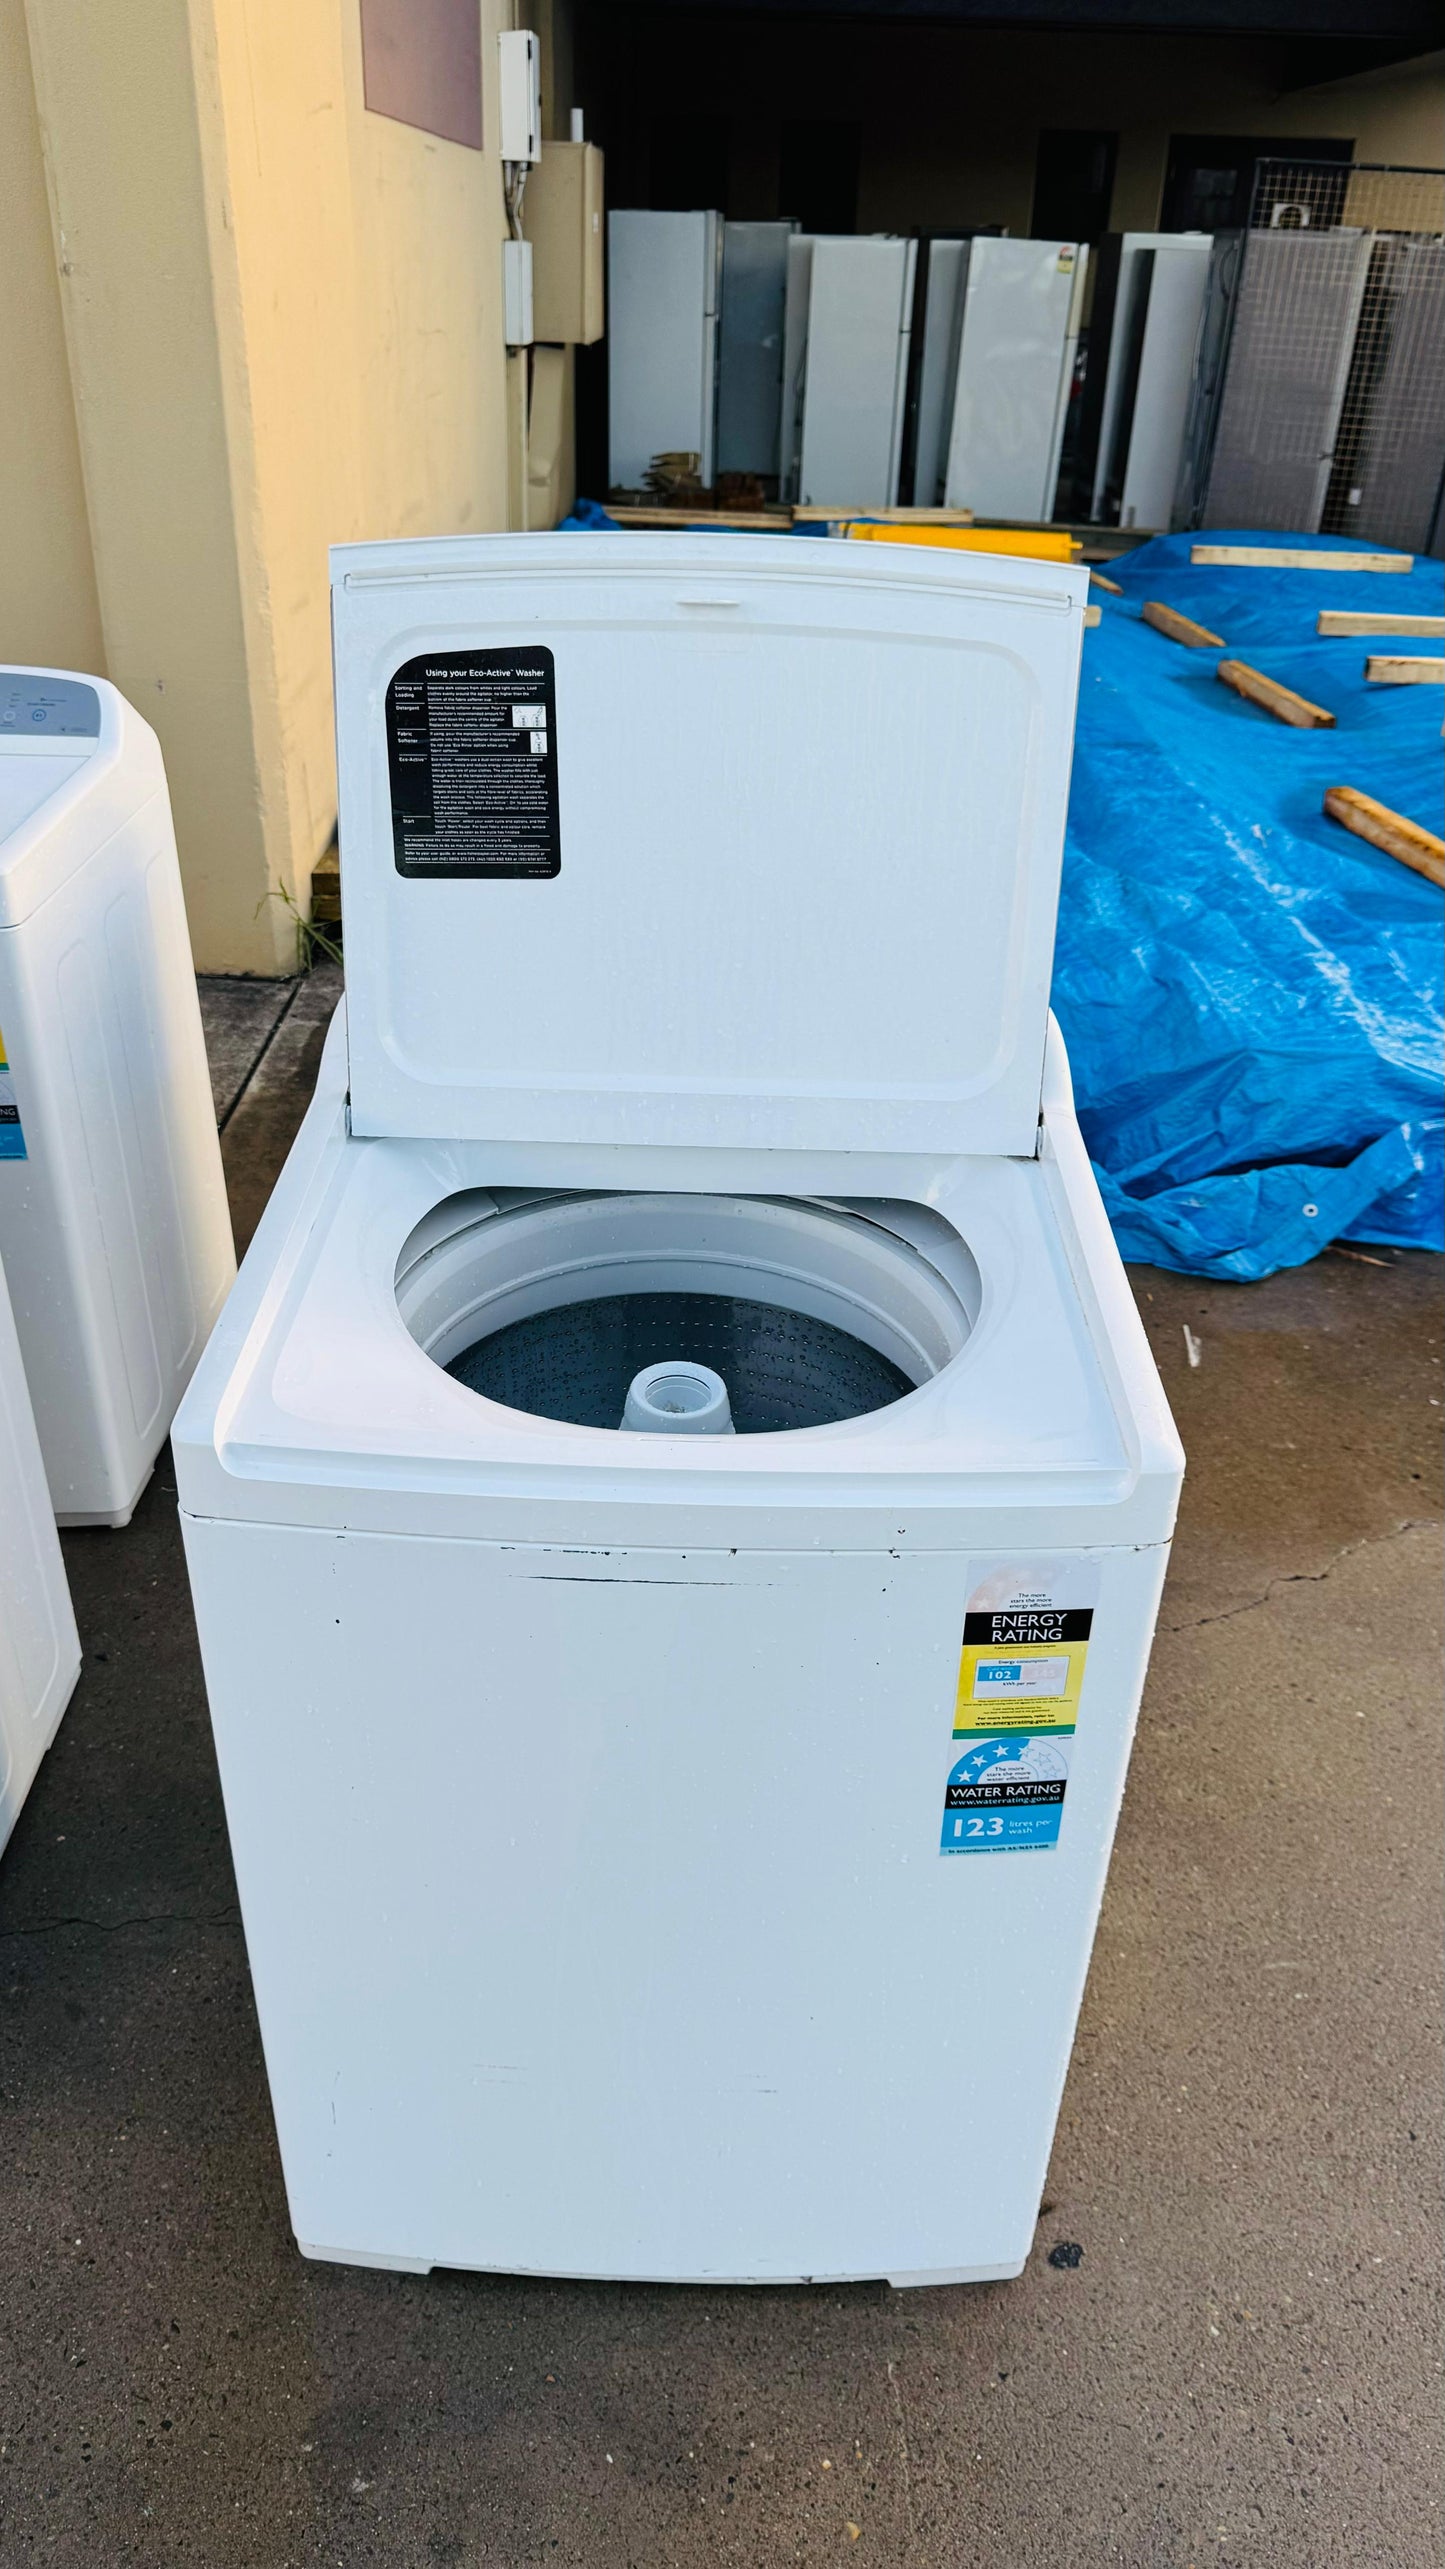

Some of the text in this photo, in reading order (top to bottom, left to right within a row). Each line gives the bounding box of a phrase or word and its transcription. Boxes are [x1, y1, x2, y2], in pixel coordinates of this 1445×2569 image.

[426, 669, 448, 678] Using
[992, 1613, 1068, 1628] ENERGY
[992, 1628, 1062, 1642] RATING
[988, 1671, 1012, 1680] 102
[951, 1784, 1061, 1798] WATER RATING
[950, 1796, 1060, 1806] www.waterrating.gov.au
[954, 1817, 1004, 1837] 123
[1036, 1819, 1052, 1828] per
